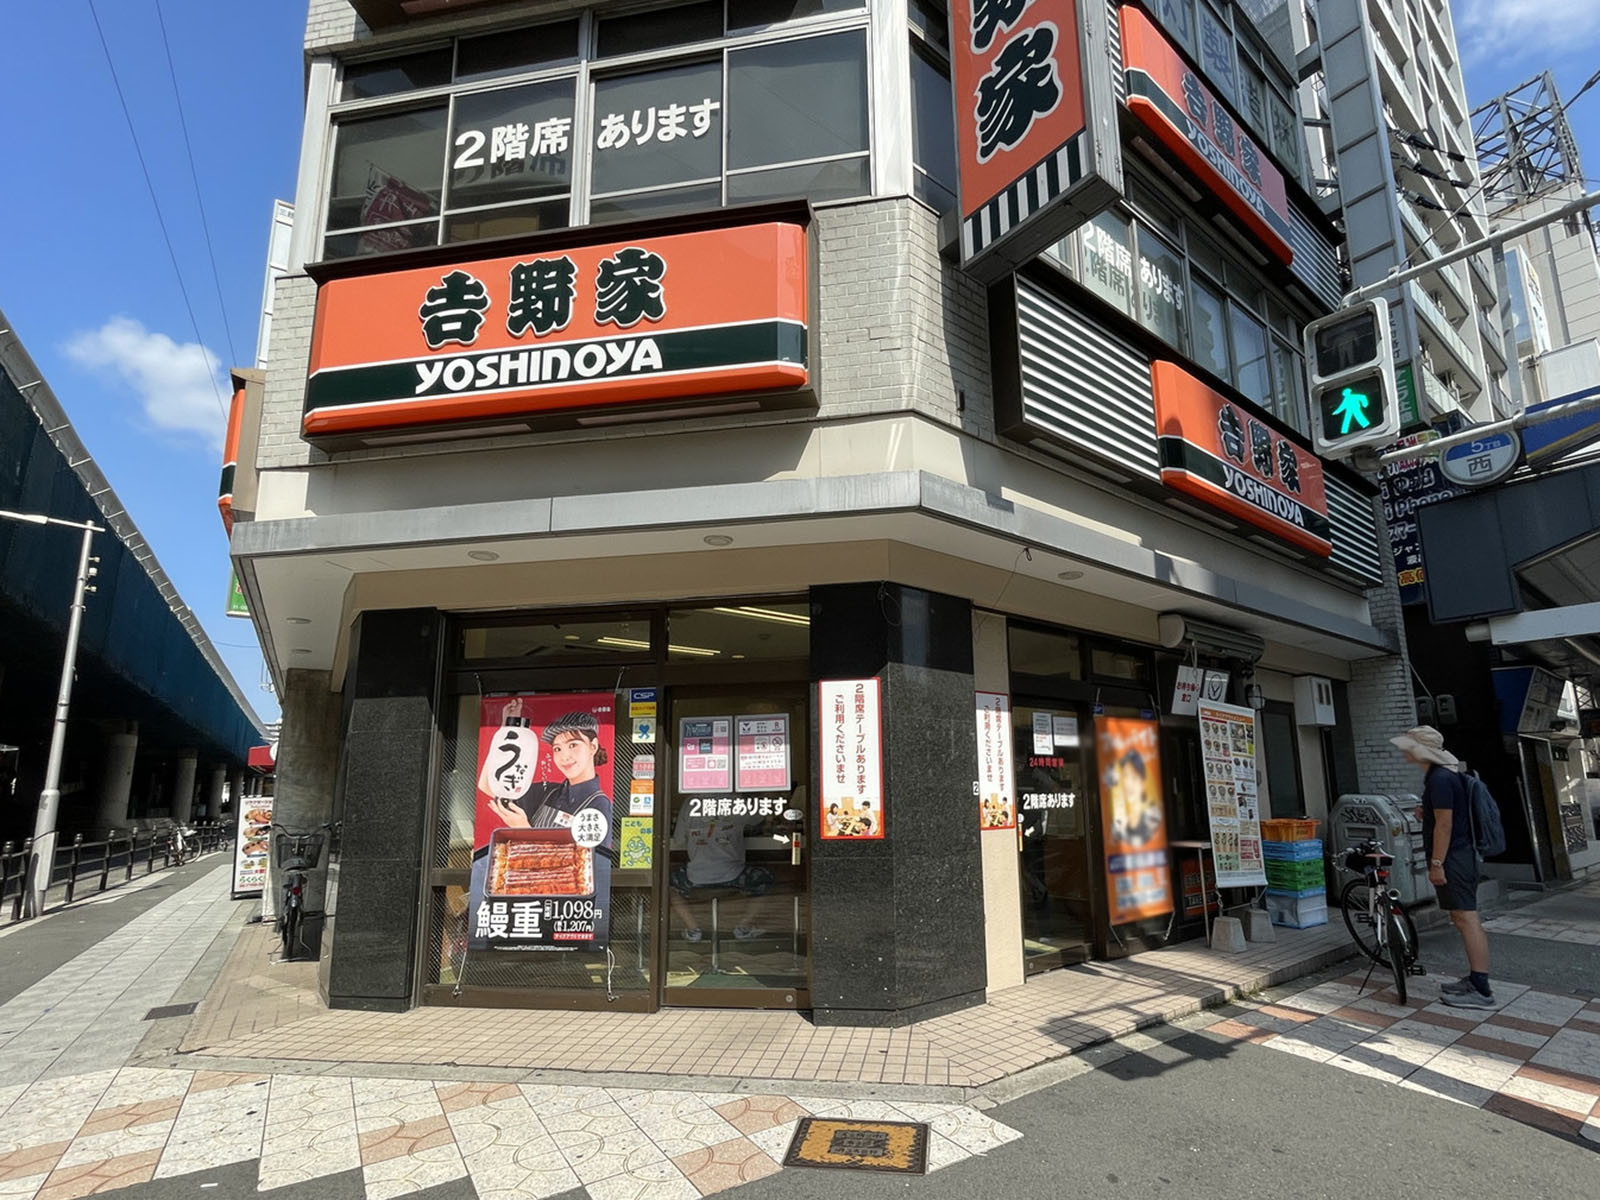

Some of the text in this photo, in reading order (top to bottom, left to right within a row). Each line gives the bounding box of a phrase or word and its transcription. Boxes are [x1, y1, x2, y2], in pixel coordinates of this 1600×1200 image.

[453, 98, 721, 170] 2階席 あります
[1180, 71, 1264, 192] 吉野家
[1185, 118, 1266, 217] YOSHINOYA
[419, 246, 667, 350] 吉野家
[1140, 256, 1184, 311] あります
[415, 338, 664, 394] YOSHINOYA
[1217, 402, 1301, 496] 吉野家
[1466, 454, 1492, 477] 西
[1222, 464, 1305, 528] YOSHINOYA
[494, 729, 529, 792] うなぎ
[833, 693, 847, 785] ご利用くださいませ
[854, 682, 867, 796] 2階席テーブルあります
[579, 813, 600, 822] うまさ
[688, 796, 788, 818] 2階席あります
[1022, 792, 1077, 811] 2階席あります
[577, 833, 601, 842] 大満足
[475, 900, 543, 939] 鰻重
[552, 899, 603, 921] 1,098円
